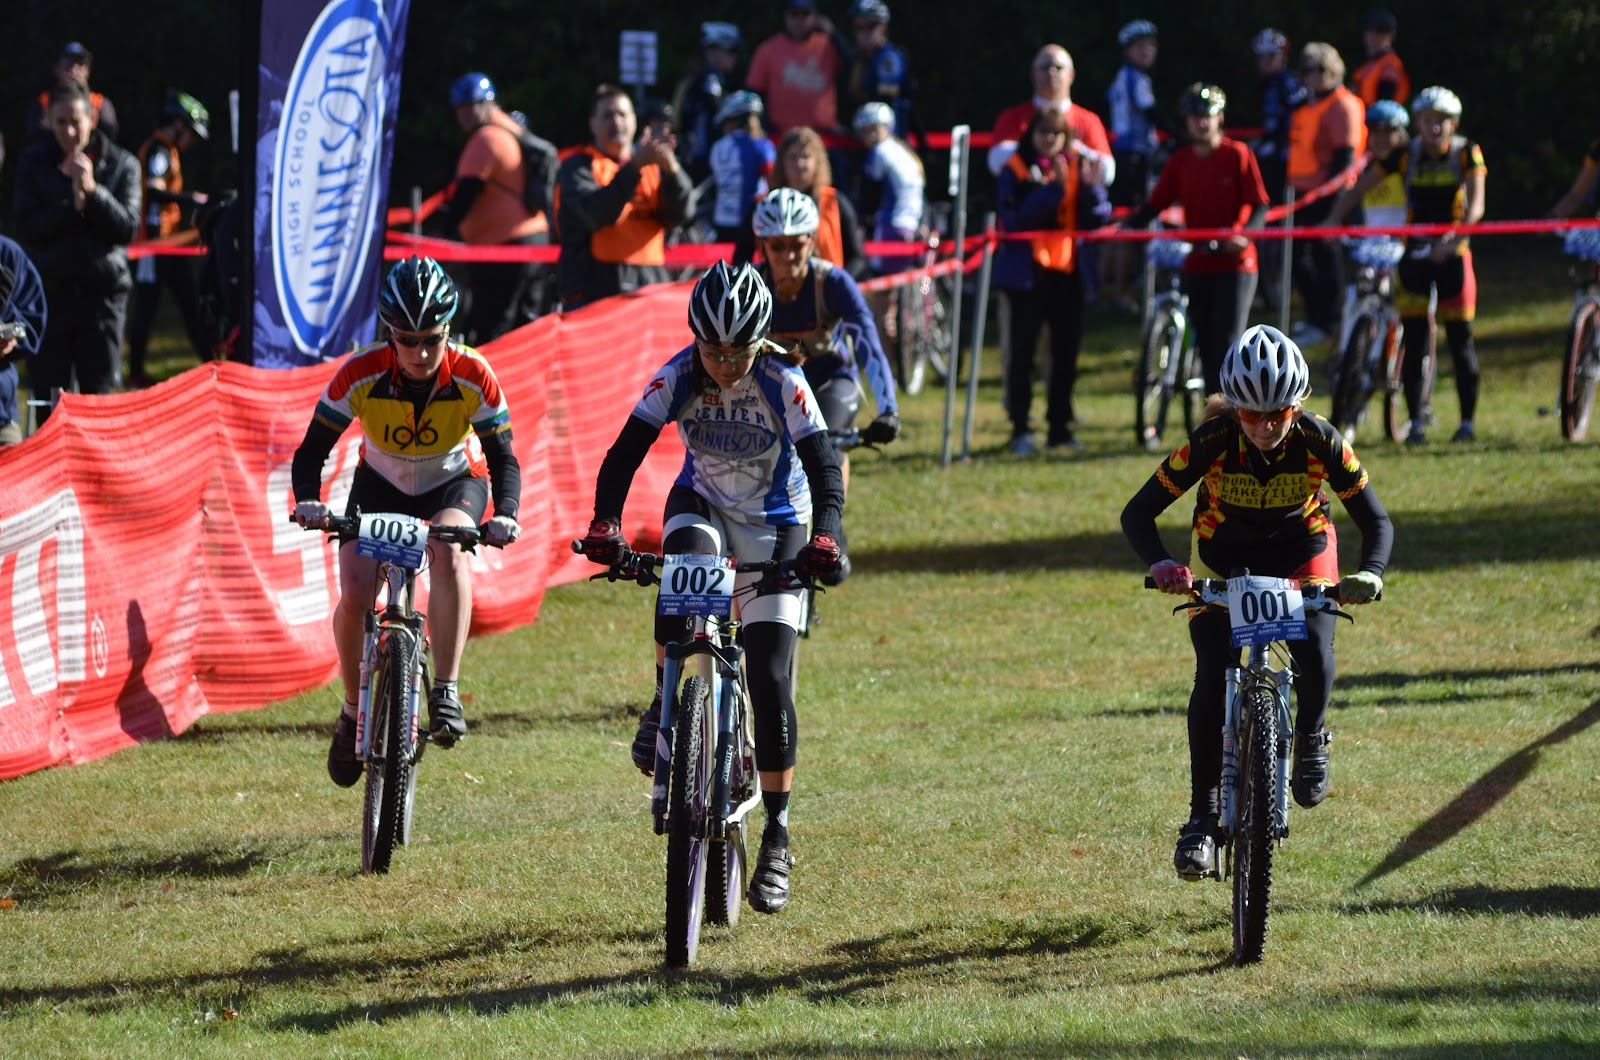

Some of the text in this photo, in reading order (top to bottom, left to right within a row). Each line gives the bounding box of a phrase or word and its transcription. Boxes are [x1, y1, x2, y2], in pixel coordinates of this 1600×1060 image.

[289, 99, 315, 257] HIGH SCHOOL
[306, 34, 373, 305] MINNESOTA
[384, 418, 438, 450] 196
[688, 424, 767, 452] MINNESOTA
[1222, 476, 1306, 487] BURNVILLE
[1221, 494, 1240, 503] MTN
[1281, 492, 1307, 504] TEAM
[370, 518, 419, 548] 003
[671, 566, 725, 595] 002
[1241, 590, 1294, 625] 001
